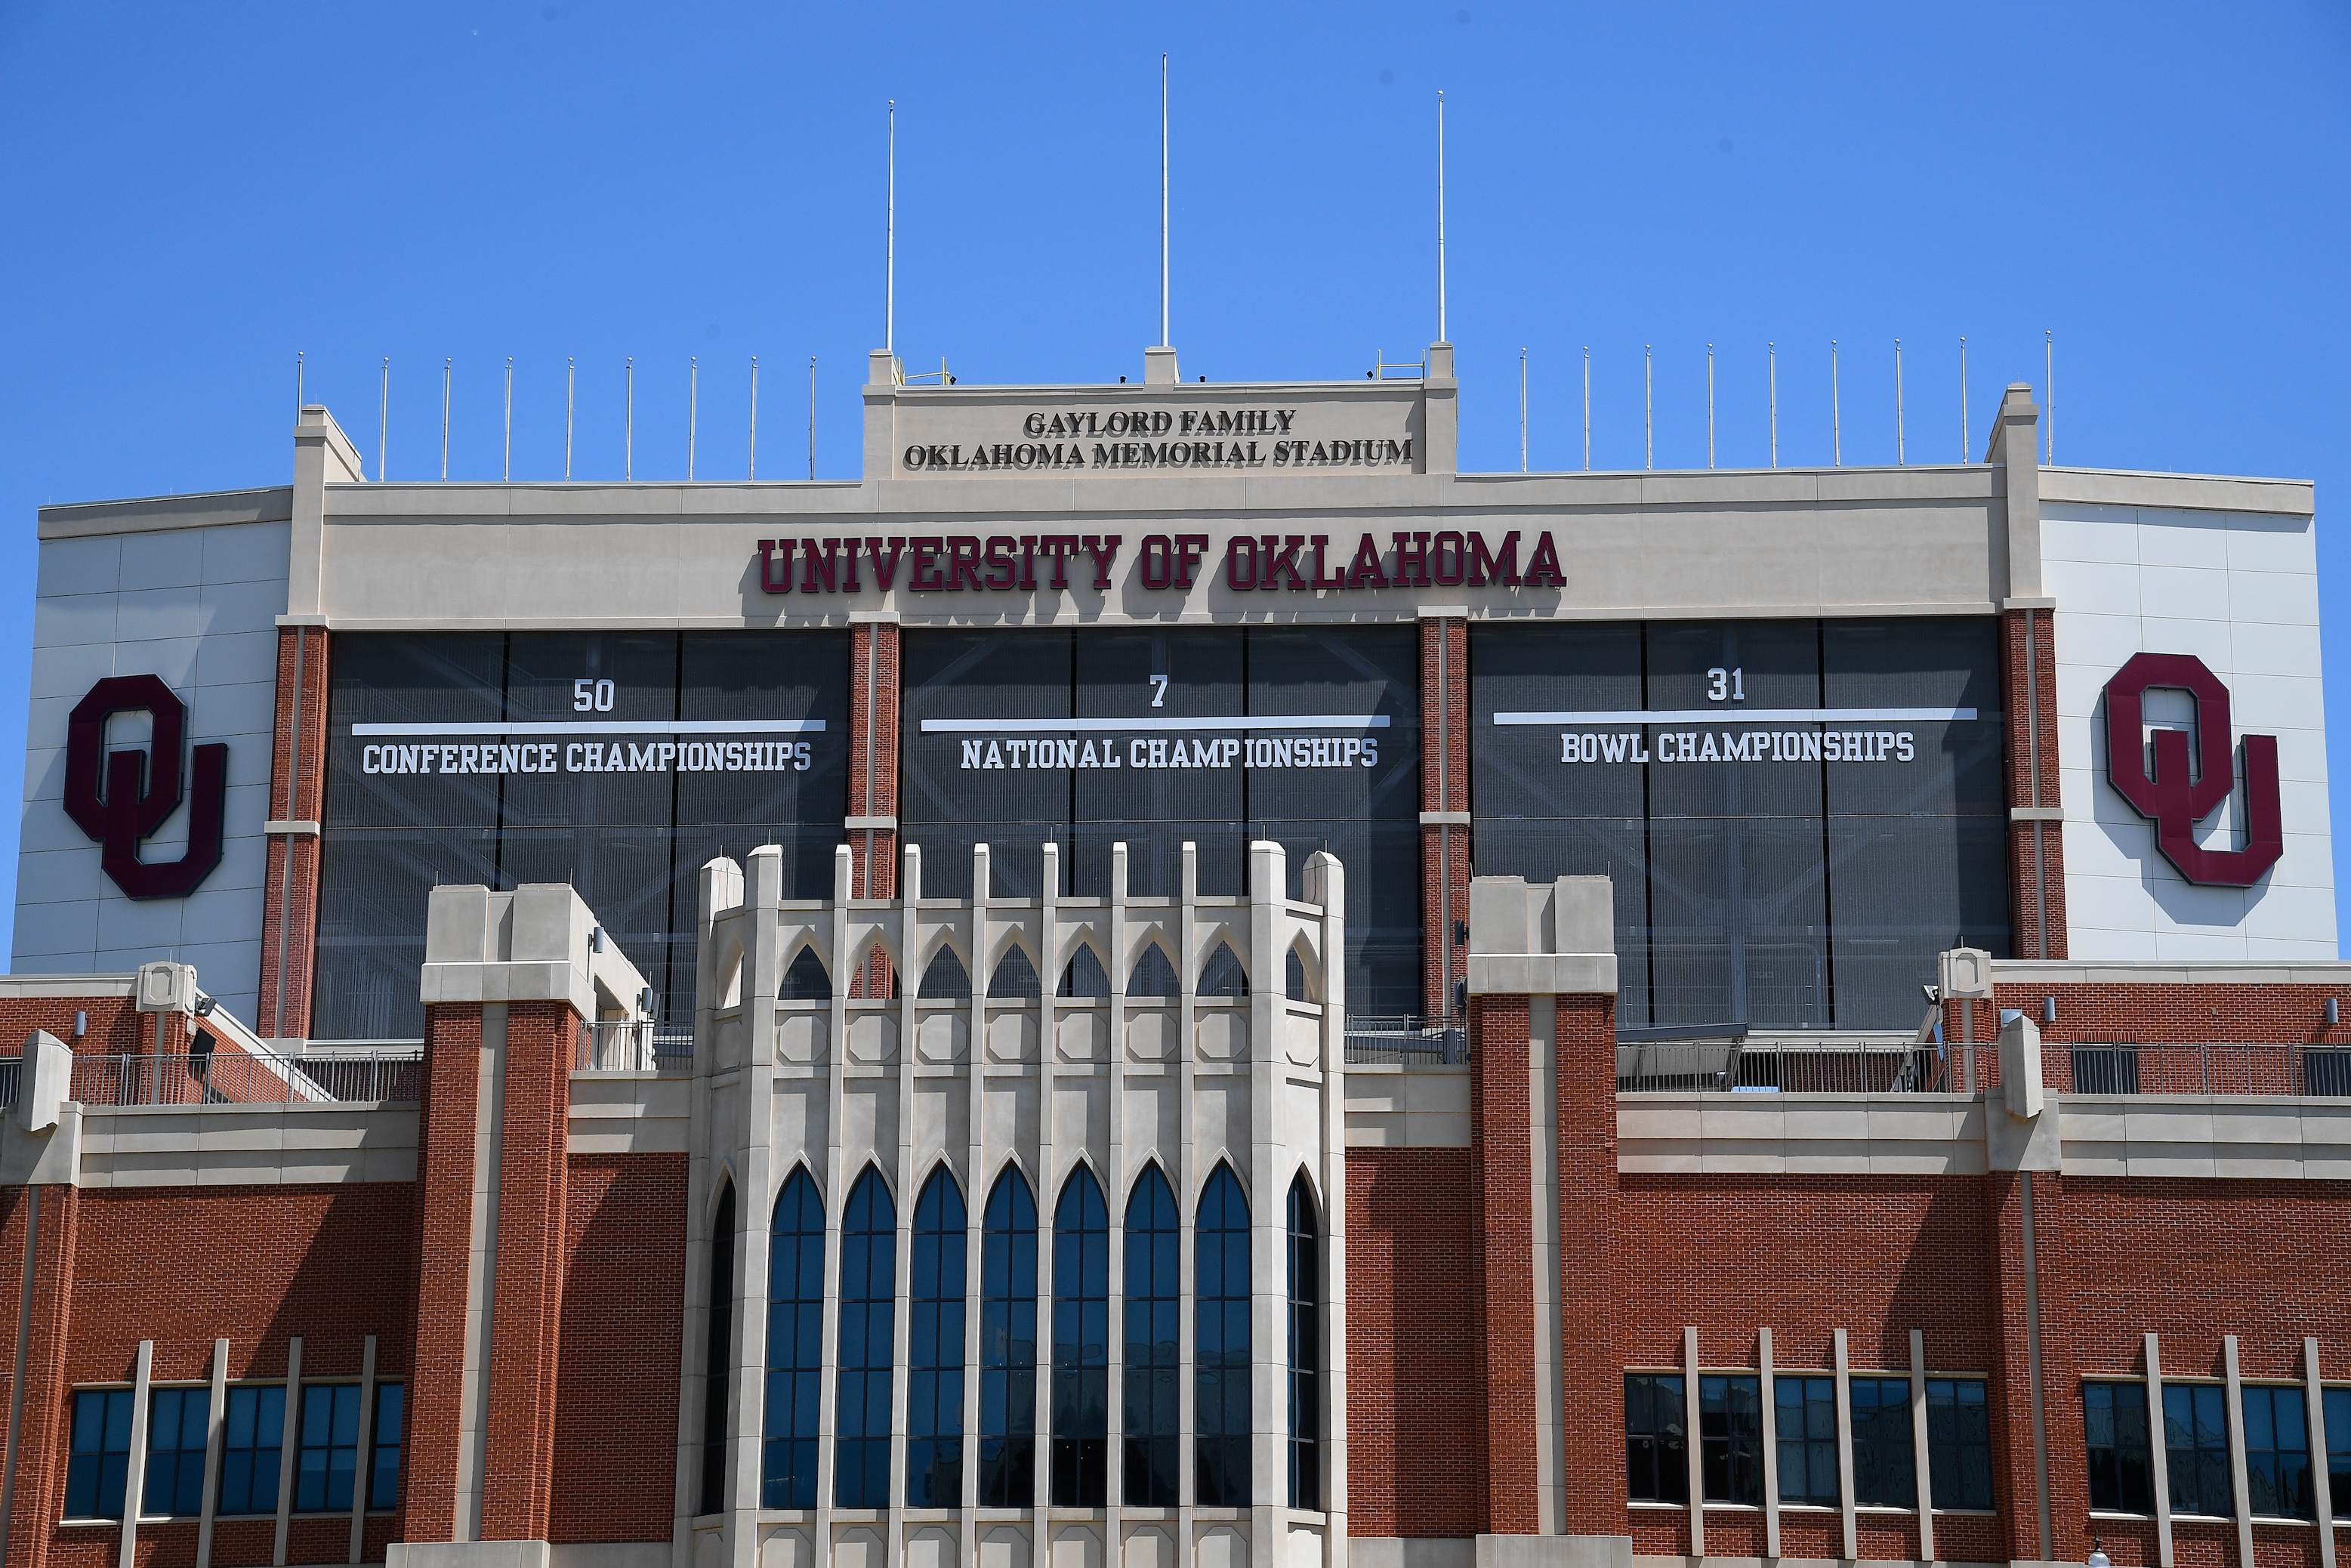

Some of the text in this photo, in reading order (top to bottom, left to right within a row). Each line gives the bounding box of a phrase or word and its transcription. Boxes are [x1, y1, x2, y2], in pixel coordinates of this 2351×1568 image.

[1025, 409, 1297, 434] GAYLORD FAMILY
[905, 438, 1414, 466] OKLAHOMA MEMORIAL STADIUM
[757, 530, 1568, 594] UNIVERSITY OF OKLAHOMA
[573, 678, 615, 711] 50
[1149, 674, 1168, 708] 7
[1707, 667, 1745, 701] 31
[363, 742, 812, 774] CONFERENCE CHAMPIONSHIPS
[960, 737, 1378, 770] NATIONAL CHAMPIONSHIPS
[1560, 731, 1914, 763] BOWL CHAMPIONSHIPS
[2103, 652, 2284, 888] OU
[63, 674, 228, 901] OU
